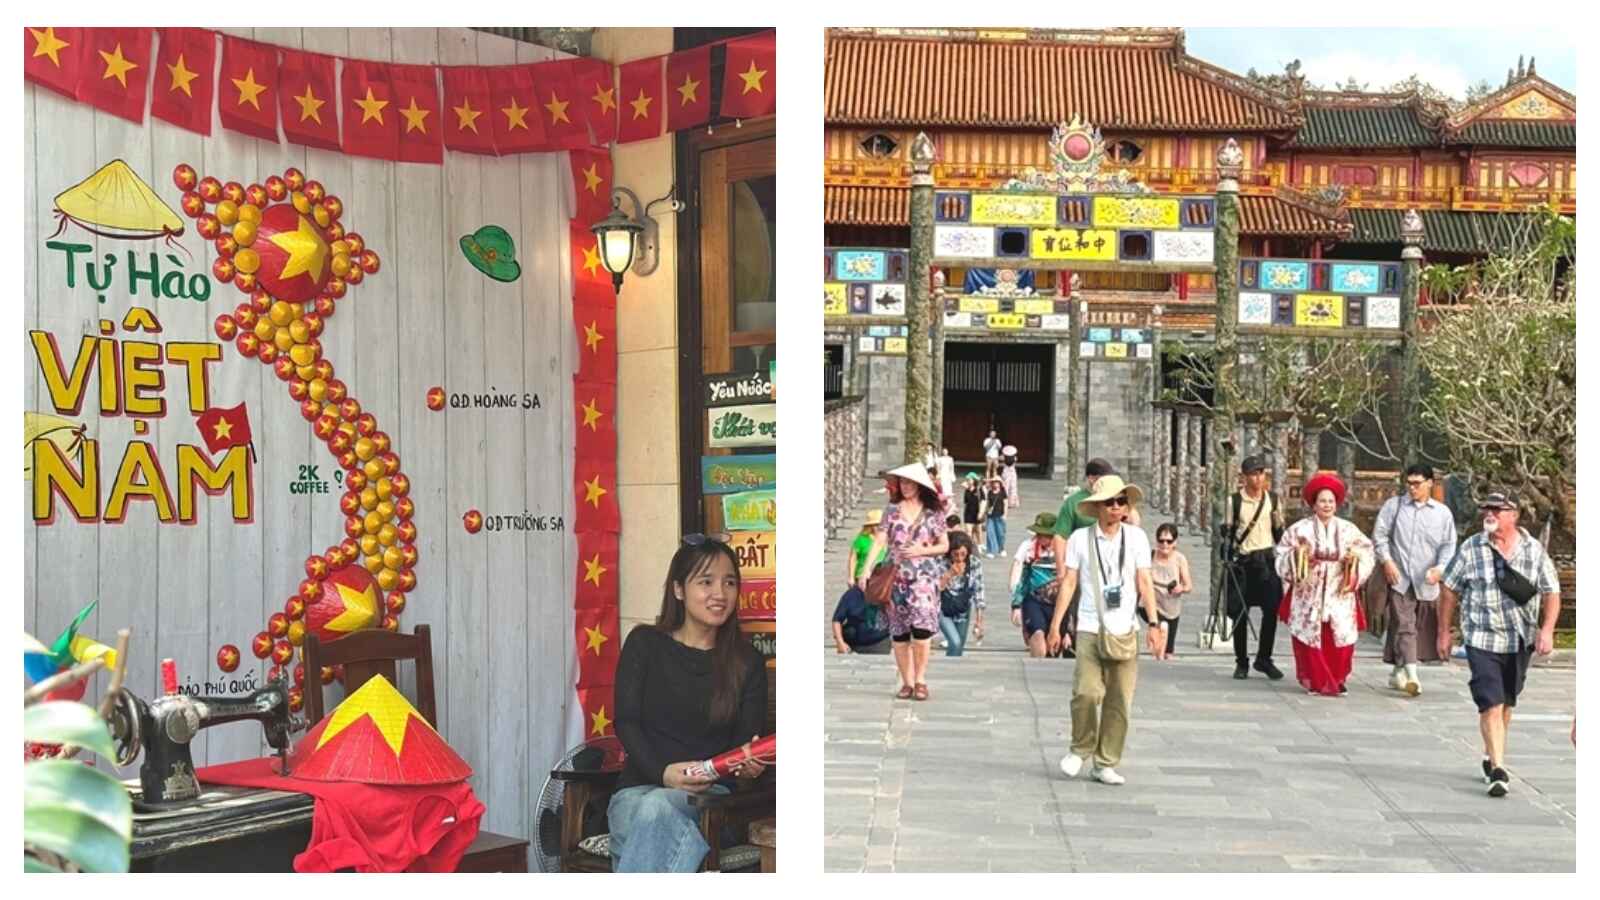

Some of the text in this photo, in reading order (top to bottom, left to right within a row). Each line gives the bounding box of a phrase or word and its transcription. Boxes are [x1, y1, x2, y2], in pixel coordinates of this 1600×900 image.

[46, 241, 211, 304] Tự Hào
[474, 386, 517, 408] HOÀNG
[521, 393, 541, 409] SA
[709, 380, 735, 401] Yêu
[298, 464, 319, 480] 2K
[290, 481, 329, 495] COFFEE
[550, 515, 565, 532] SA
[735, 533, 769, 568] BẤT
[739, 591, 758, 609] NG
[205, 676, 227, 696] PHÚ
[229, 668, 259, 694] QUỐC
